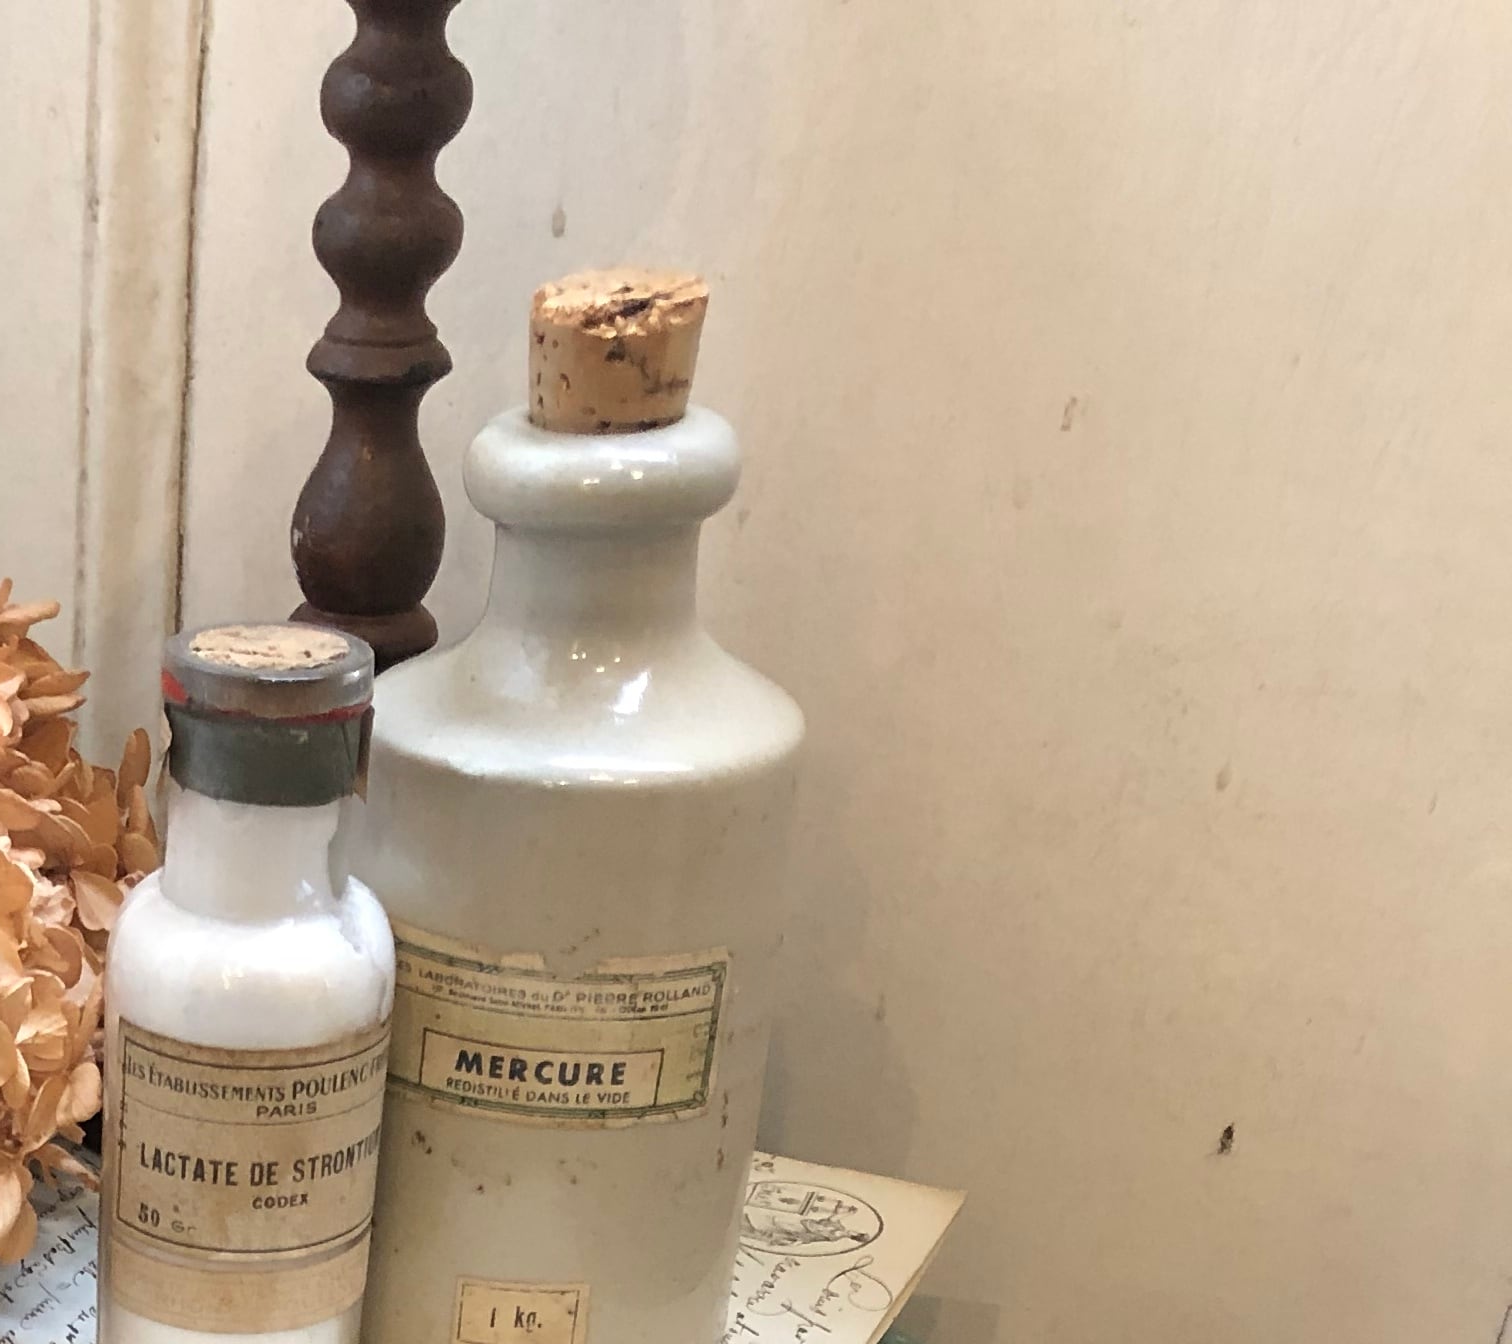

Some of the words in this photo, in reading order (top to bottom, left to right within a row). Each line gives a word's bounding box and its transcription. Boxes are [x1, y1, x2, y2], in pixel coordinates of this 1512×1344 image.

[642, 985, 711, 1002] ROLLAND
[454, 1049, 628, 1087] MERCURE
[291, 1063, 367, 1100] POULENC
[525, 1089, 570, 1105] DANS
[575, 1091, 591, 1105] LE
[596, 1090, 632, 1105] VIDE
[256, 1101, 318, 1119] PARIS
[139, 1142, 239, 1187] LACTATE
[249, 1161, 279, 1187] DE
[251, 1192, 309, 1210] CODEX
[138, 1202, 161, 1228] 50
